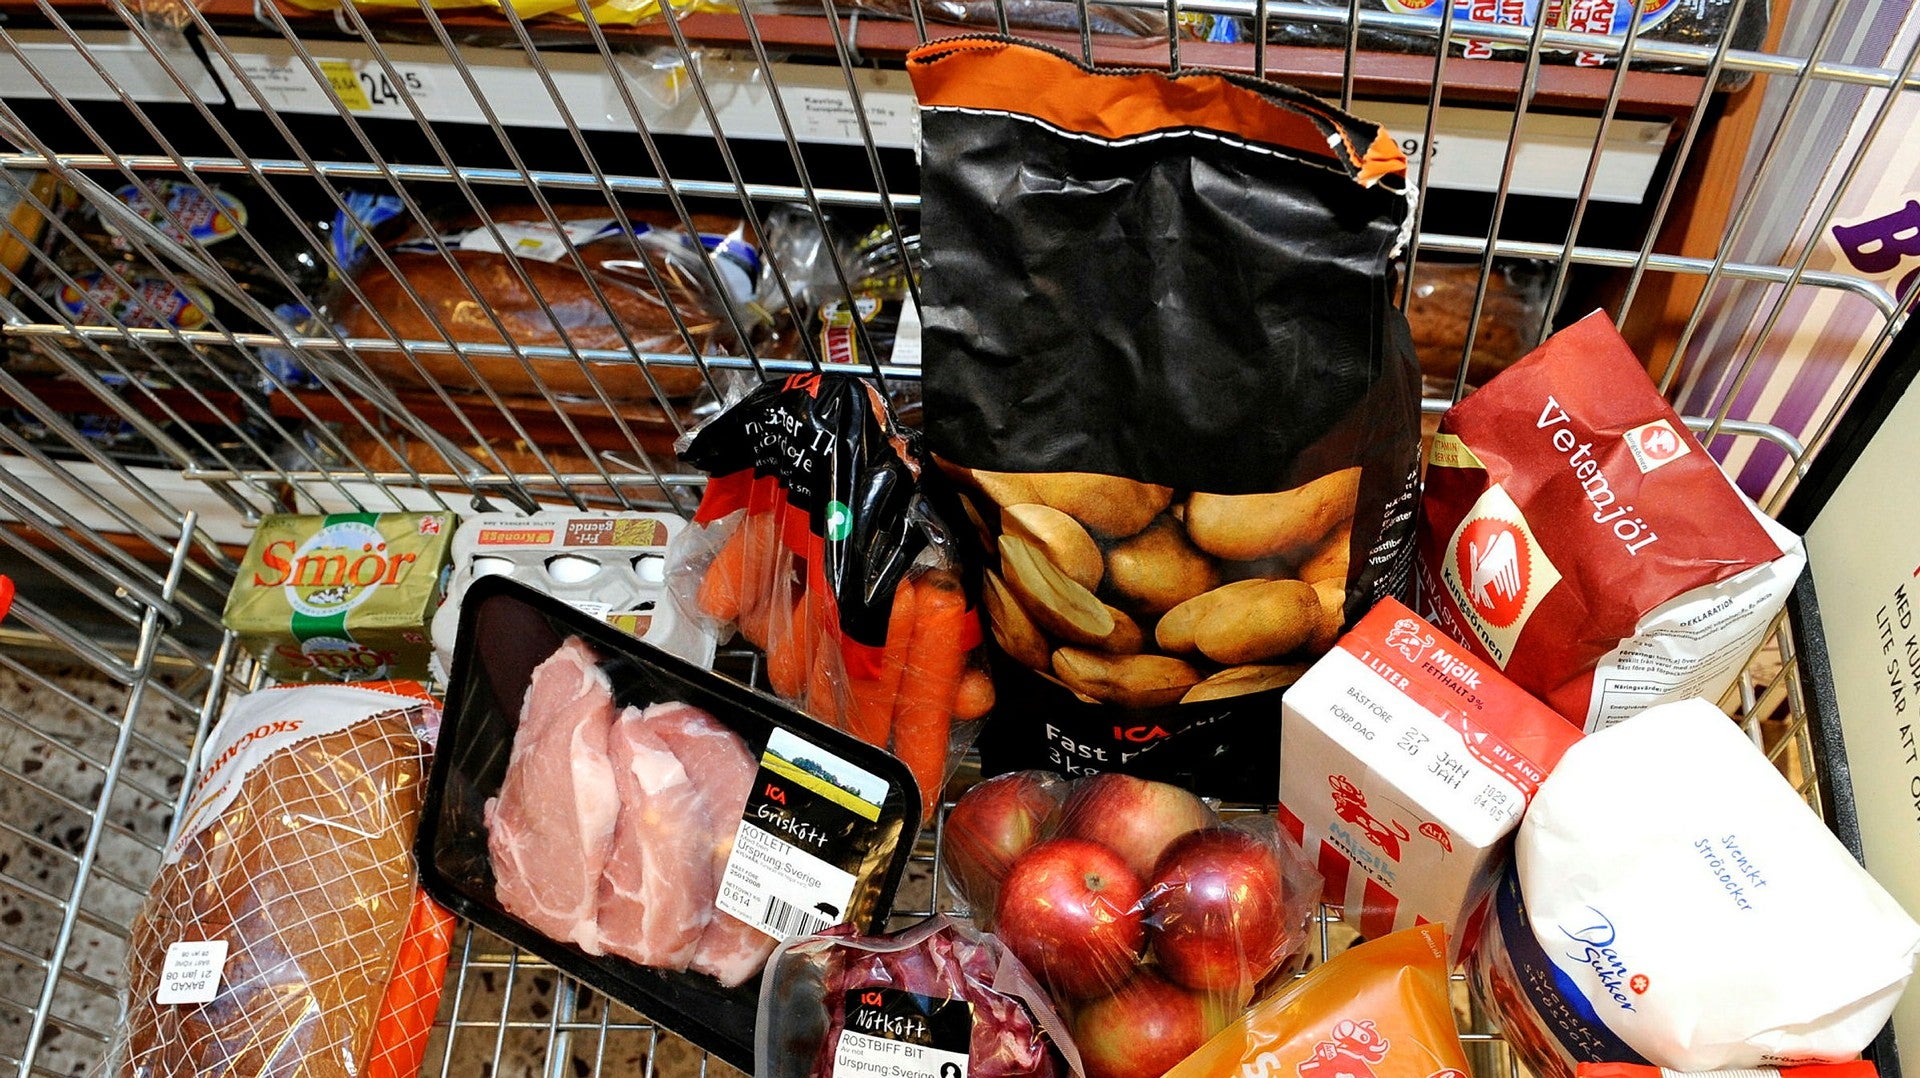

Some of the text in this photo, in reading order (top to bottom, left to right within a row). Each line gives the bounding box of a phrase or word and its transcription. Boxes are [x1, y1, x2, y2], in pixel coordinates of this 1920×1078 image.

[360, 72, 398, 105] 24
[1626, 432, 1649, 471] Kungsörnen
[1536, 395, 1659, 557] Vetemjöl
[575, 533, 600, 544] Fri-
[253, 540, 416, 588] Smör
[1443, 566, 1503, 662] Kungsörnen
[1894, 582, 1912, 630] MED
[1369, 656, 1410, 693] LITER
[1421, 661, 1485, 711] FETTHALT 3%
[1429, 648, 1484, 691] Mjölk
[1876, 605, 1895, 656] LITE
[1899, 723, 1918, 765] ATT
[1346, 686, 1393, 724] BÄST FÖRE
[1045, 722, 1109, 762] Fast
[1113, 725, 1172, 743] ICA
[1352, 719, 1376, 742] DAG
[1404, 726, 1431, 745] 27
[1436, 750, 1471, 780] JAN
[1493, 744, 1511, 762] RIV
[764, 783, 787, 805] ICA
[741, 824, 793, 856] KOTLETT
[757, 803, 829, 848] Griskött
[1423, 822, 1450, 845] Arla
[1694, 837, 1753, 913] Strösocker
[1721, 834, 1769, 890] Svenskt
[723, 886, 750, 907] 0.614
[861, 991, 883, 1008] ICA
[1565, 946, 1637, 1015] Sukker
[856, 1009, 927, 1039] Nötkött
[842, 1033, 925, 1060] ROSTBIFF BIT
